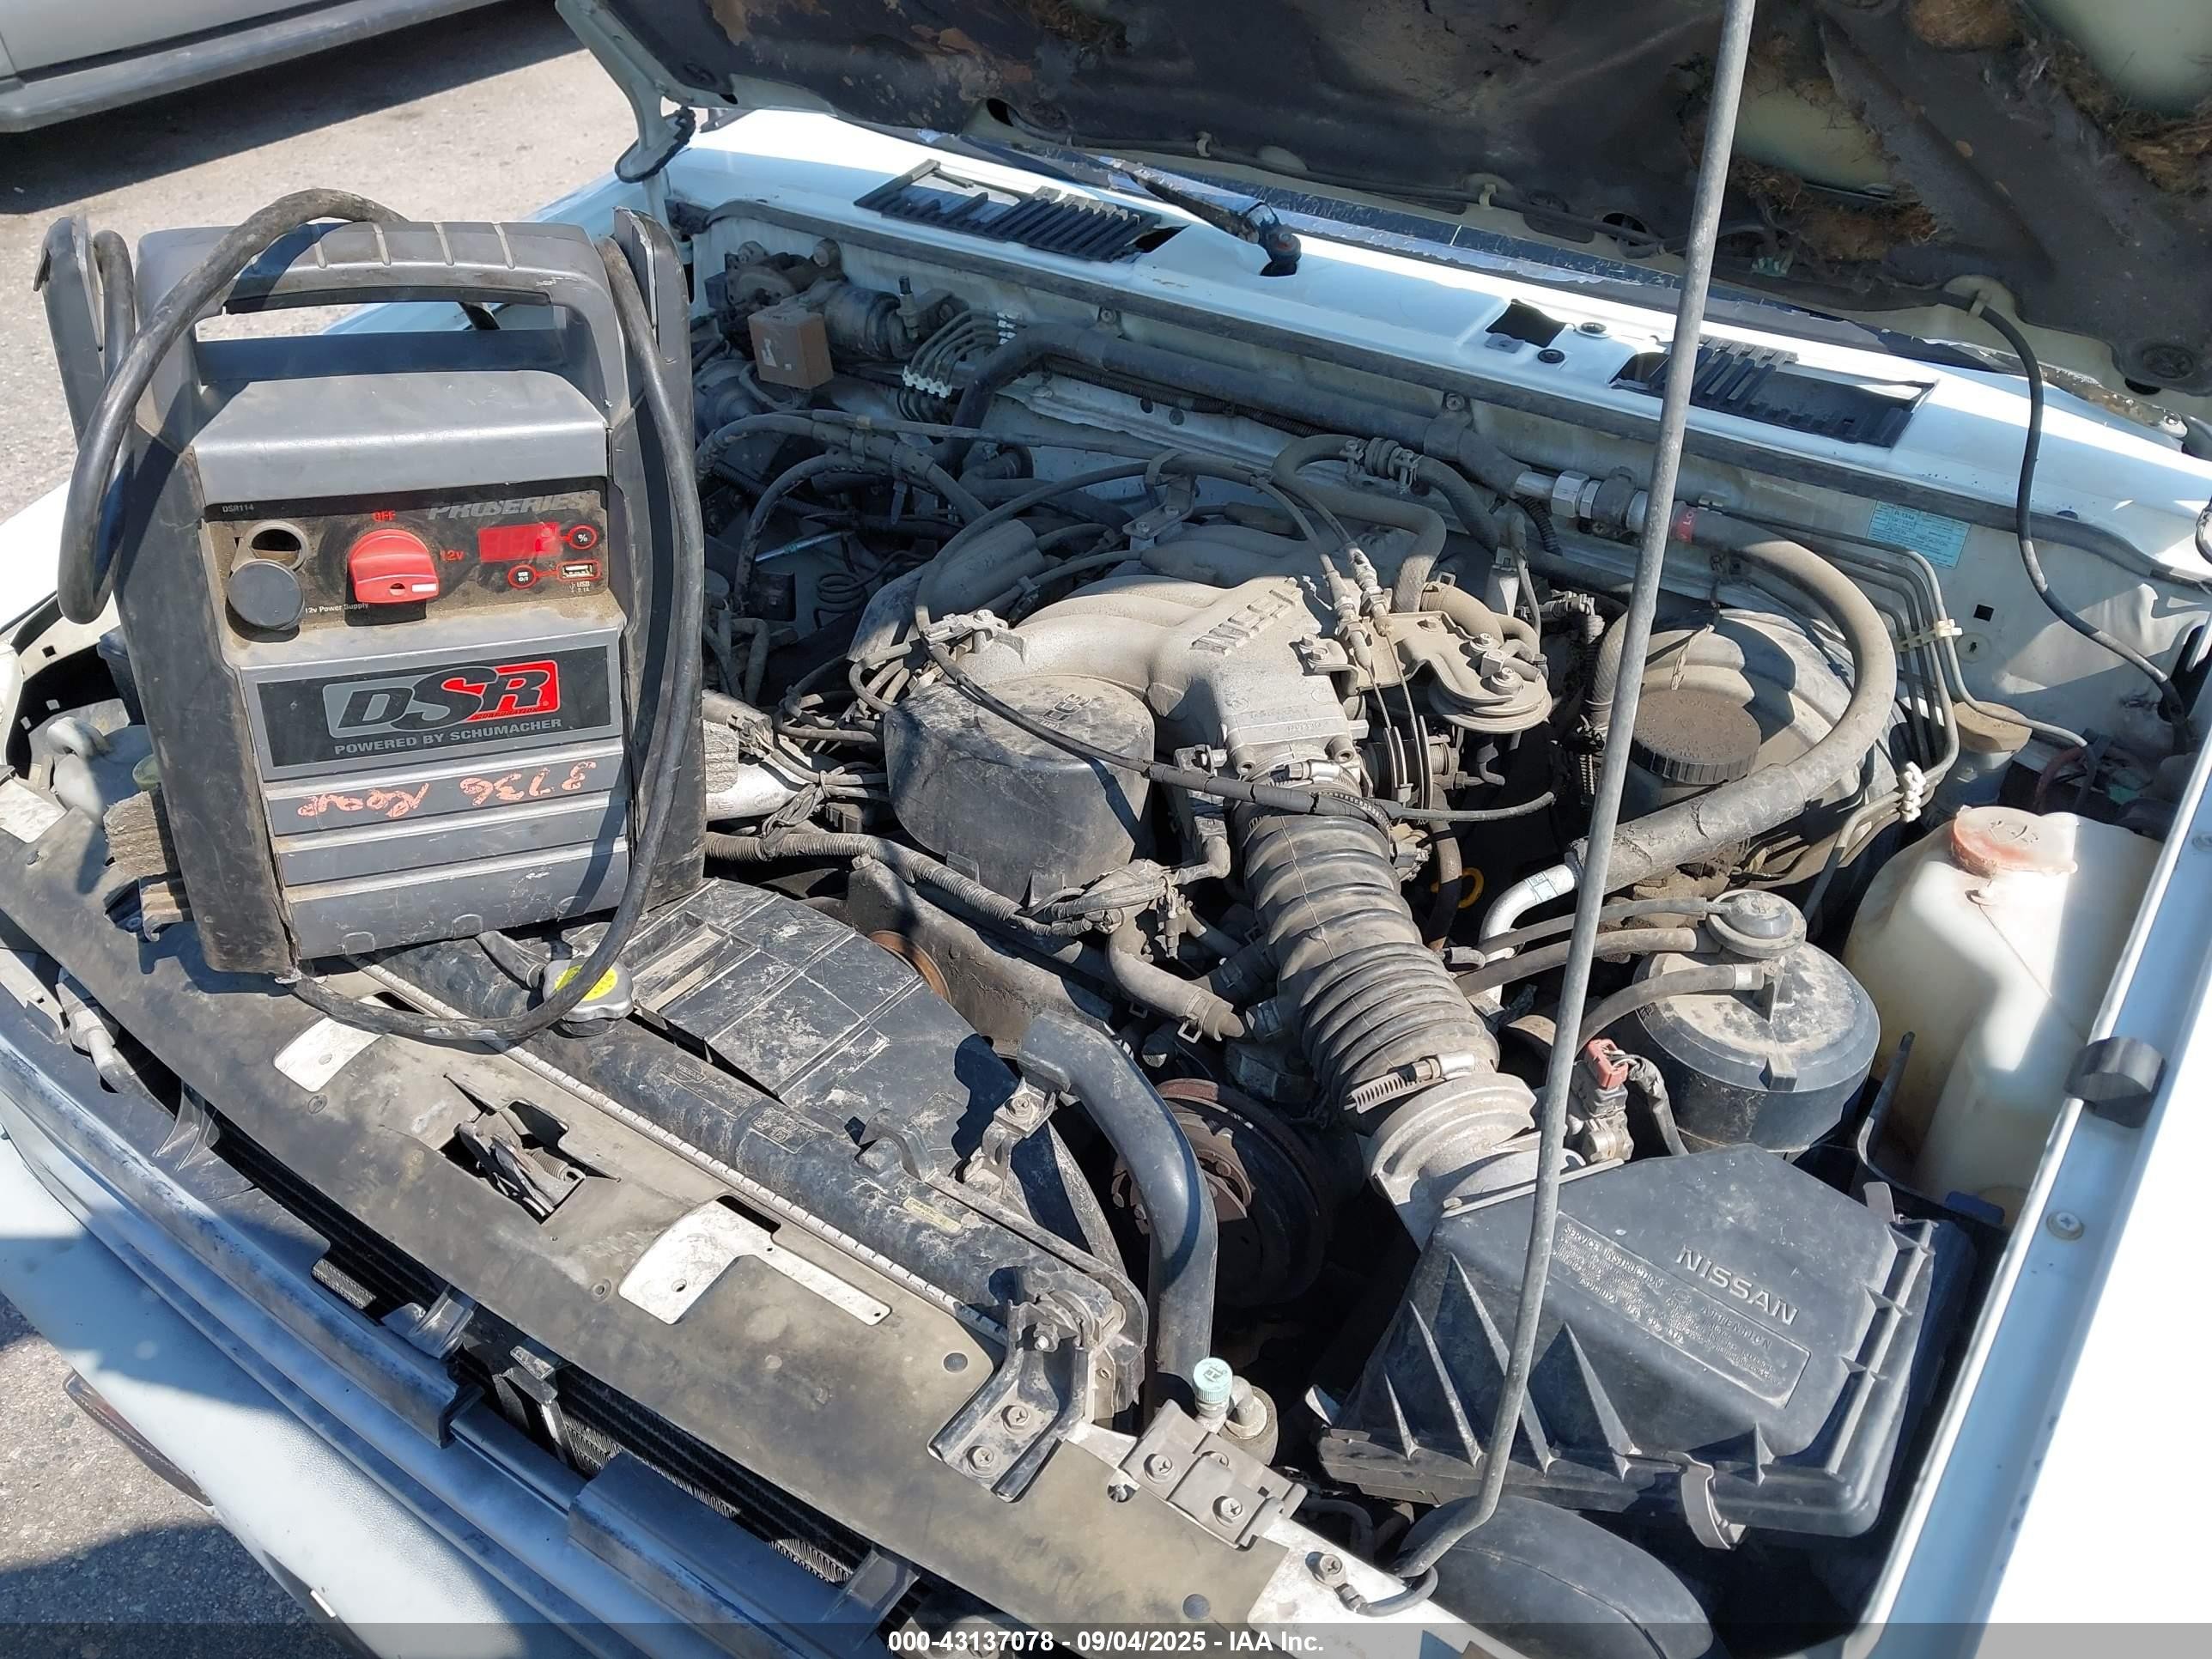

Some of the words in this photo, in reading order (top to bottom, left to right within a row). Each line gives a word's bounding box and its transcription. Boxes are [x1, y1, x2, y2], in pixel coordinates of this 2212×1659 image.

[222, 503, 254, 514] DSR114
[373, 510, 397, 522] OFF
[319, 605, 343, 614] Power
[343, 602, 369, 611] Supply
[337, 665, 550, 732] DSR
[334, 737, 417, 756] POWERED
[423, 734, 444, 745] BY
[450, 718, 563, 741] SCHUMACHER
[1564, 1223, 1601, 1252] SERVICE
[1603, 1247, 1664, 1289] INSTRUCTION
[1674, 1244, 1800, 1327] NISSAN
[1701, 1304, 1772, 1350] ATTENTION
